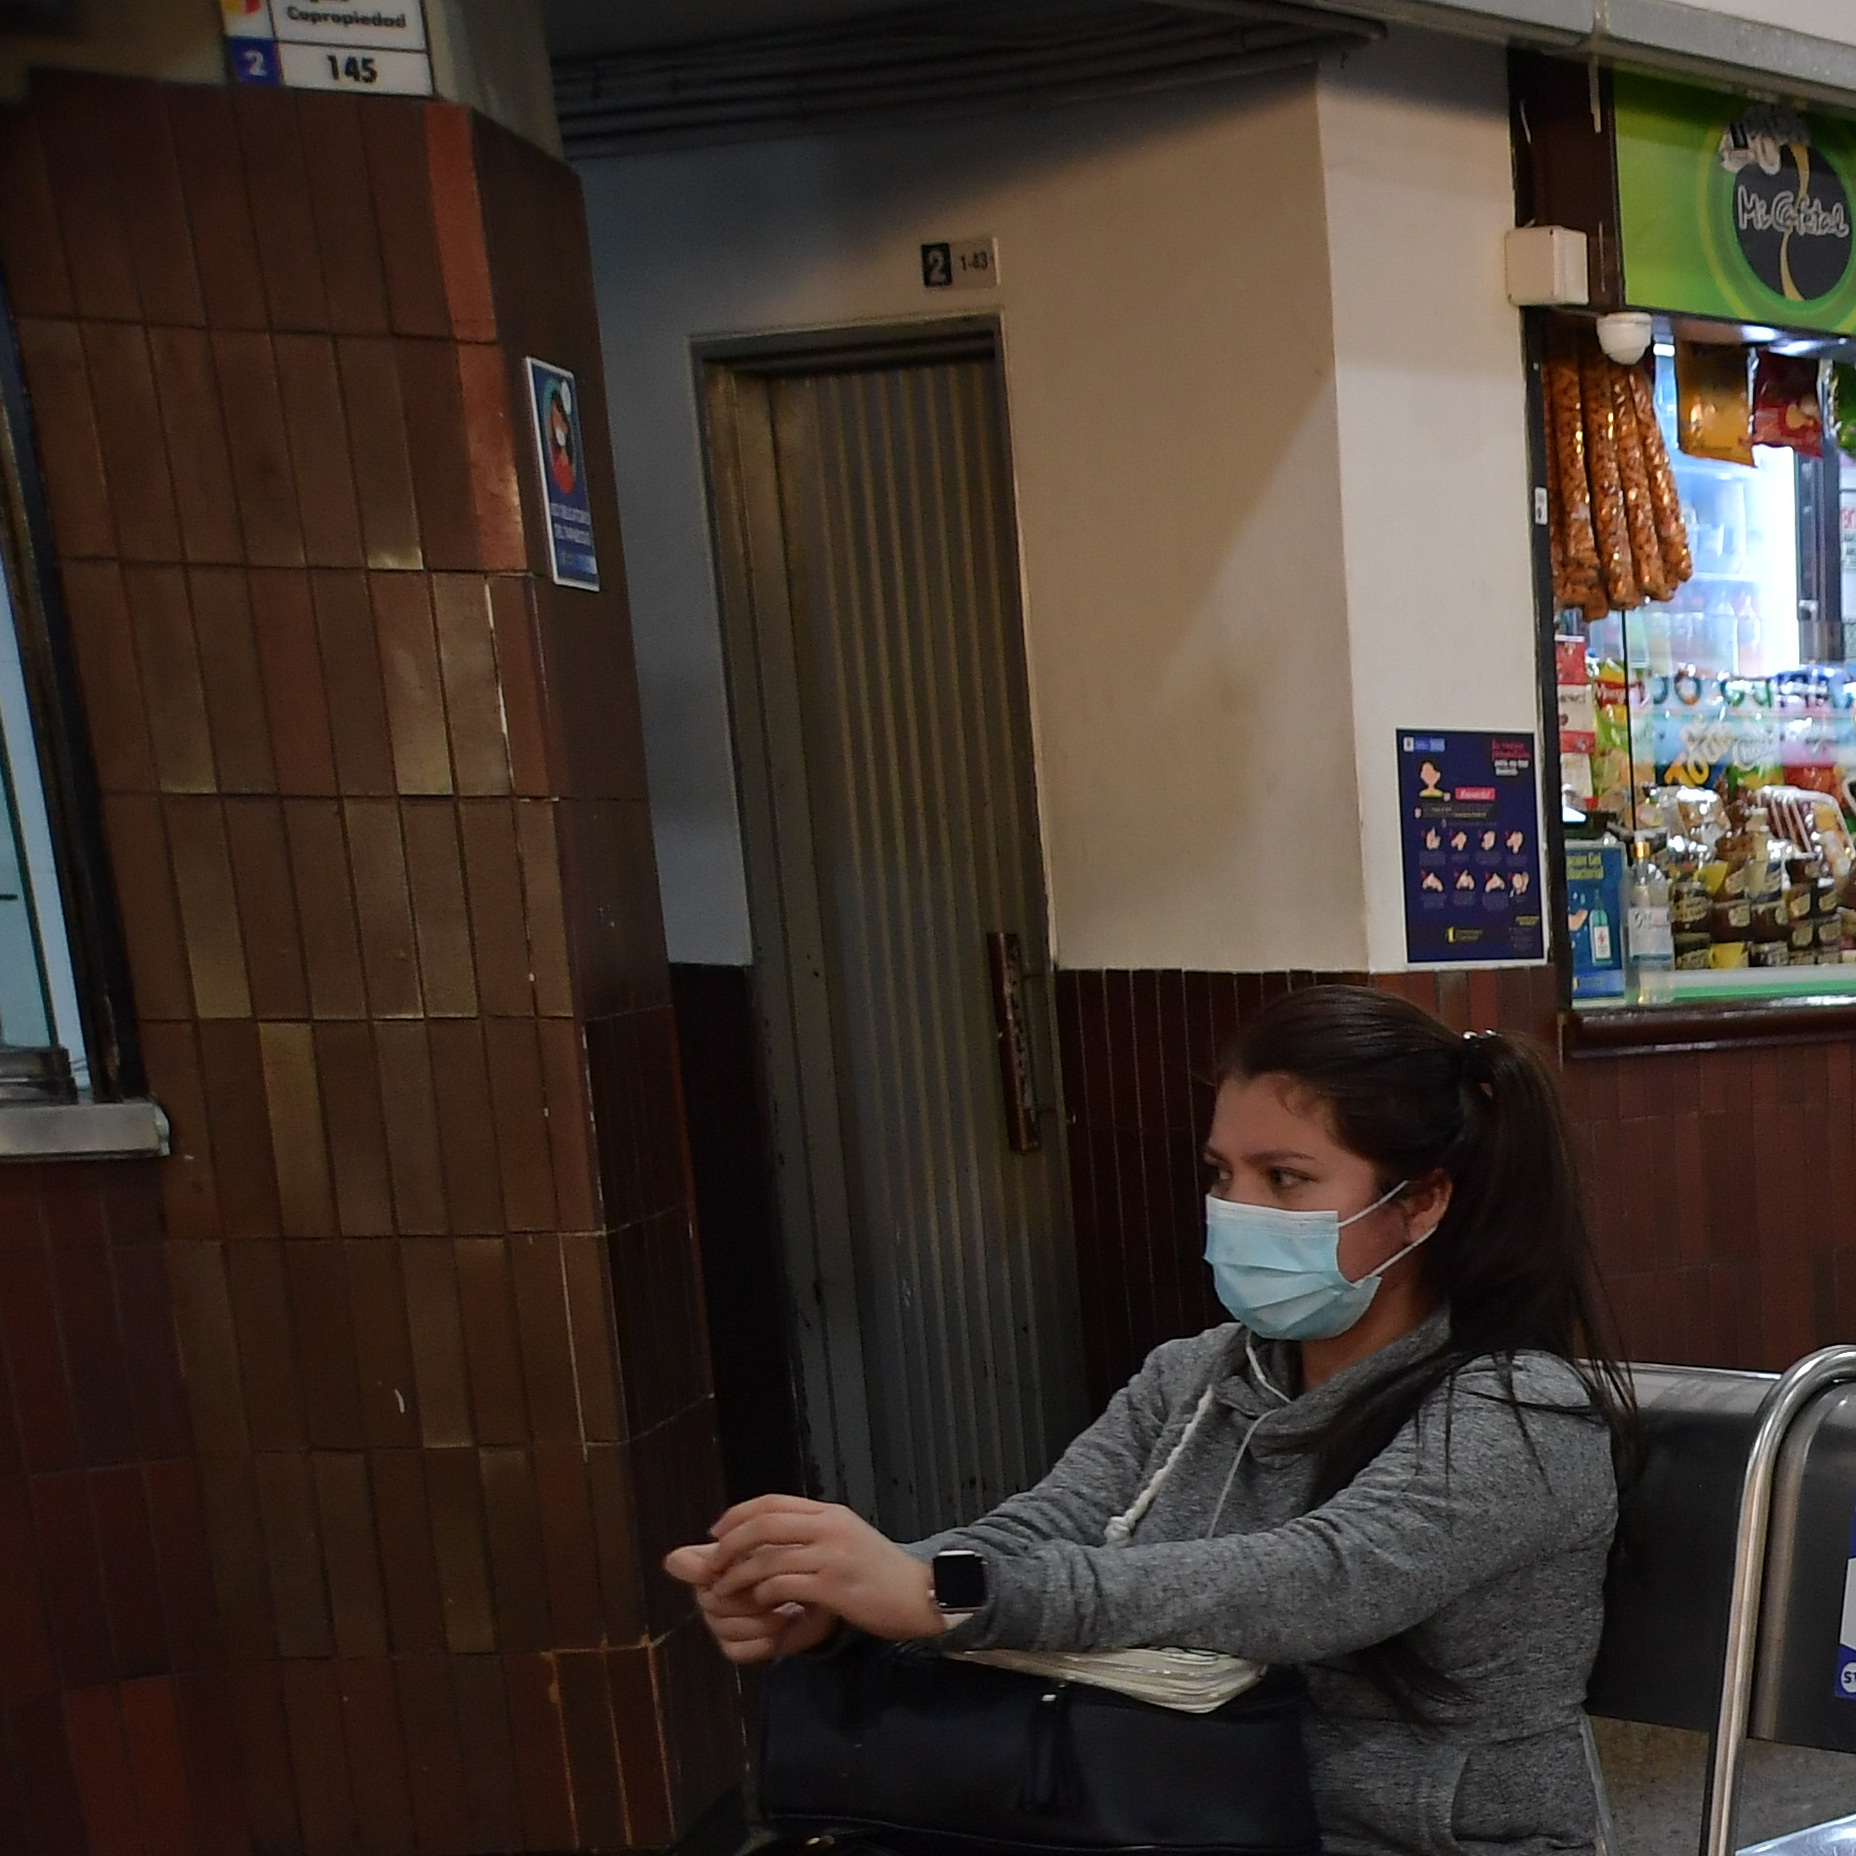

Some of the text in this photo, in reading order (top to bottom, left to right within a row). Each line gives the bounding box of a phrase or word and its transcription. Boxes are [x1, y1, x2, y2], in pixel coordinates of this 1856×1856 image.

[286, 6, 407, 28] Copropiedad
[243, 50, 266, 77] 2
[326, 53, 379, 84] 145
